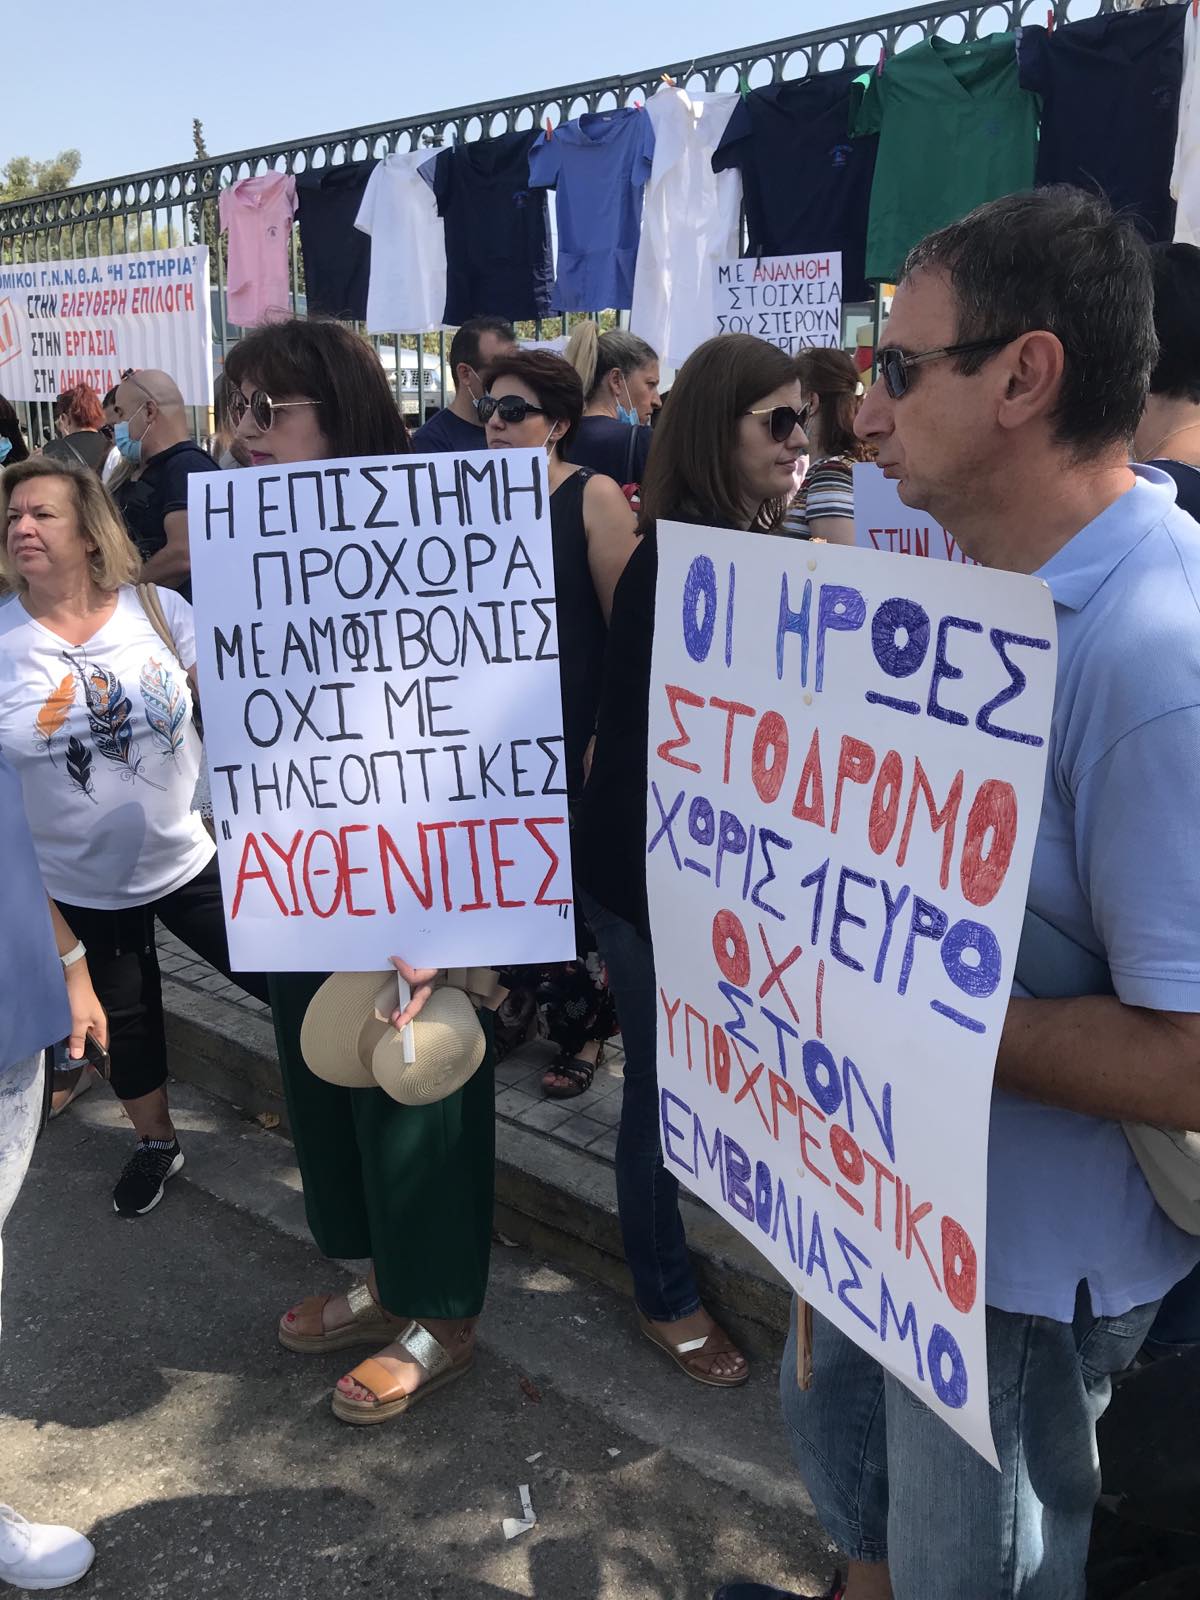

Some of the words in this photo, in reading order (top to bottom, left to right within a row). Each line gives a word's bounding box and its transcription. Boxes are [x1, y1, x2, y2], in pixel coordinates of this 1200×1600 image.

[0, 272, 37, 289] ΜΙΚΟΙ
[27, 293, 57, 319] ΣΤΗΝ
[61, 287, 127, 317] ΕΛΕΥΘΕΡΗ
[131, 283, 194, 314] ΕΠΙΛΟΓΗ
[718, 264, 745, 284] ΜΕ
[753, 258, 830, 282] ΑΝΑΛΗΘΗ
[728, 281, 842, 309] ΣΤΟΙΧΕΙΑ
[31, 331, 61, 356] ΣΤΗΝ
[65, 330, 117, 356] ΕΡΓΑΣΙΑ
[717, 314, 754, 336] ΣΟΥ
[758, 307, 839, 334] ΣΤΕΡΟΥΝ
[34, 369, 56, 393] ΣΤΗ
[205, 481, 235, 540] Η
[258, 456, 543, 537] ΕΠΙΣΤΗΜΗ
[683, 554, 736, 668] ΟΙ
[776, 570, 1052, 748] ΗΡΩΕΣ
[244, 682, 364, 748] ΟΧΙ
[384, 675, 471, 740] ΜΕ
[213, 735, 569, 815] ΤΗΛΕΟΠΤΙΚΕΣ
[648, 780, 793, 921] ΧΩΡΙΣ
[712, 908, 825, 1039] ΟΧΙ
[718, 981, 896, 1163] ΣΤΟΝ
[660, 986, 978, 1314] ΥΠΟΧΡΕΩΤΙΚΟ
[661, 1086, 969, 1410] ΕΜΒΟΛΙΑΣΜΟ
